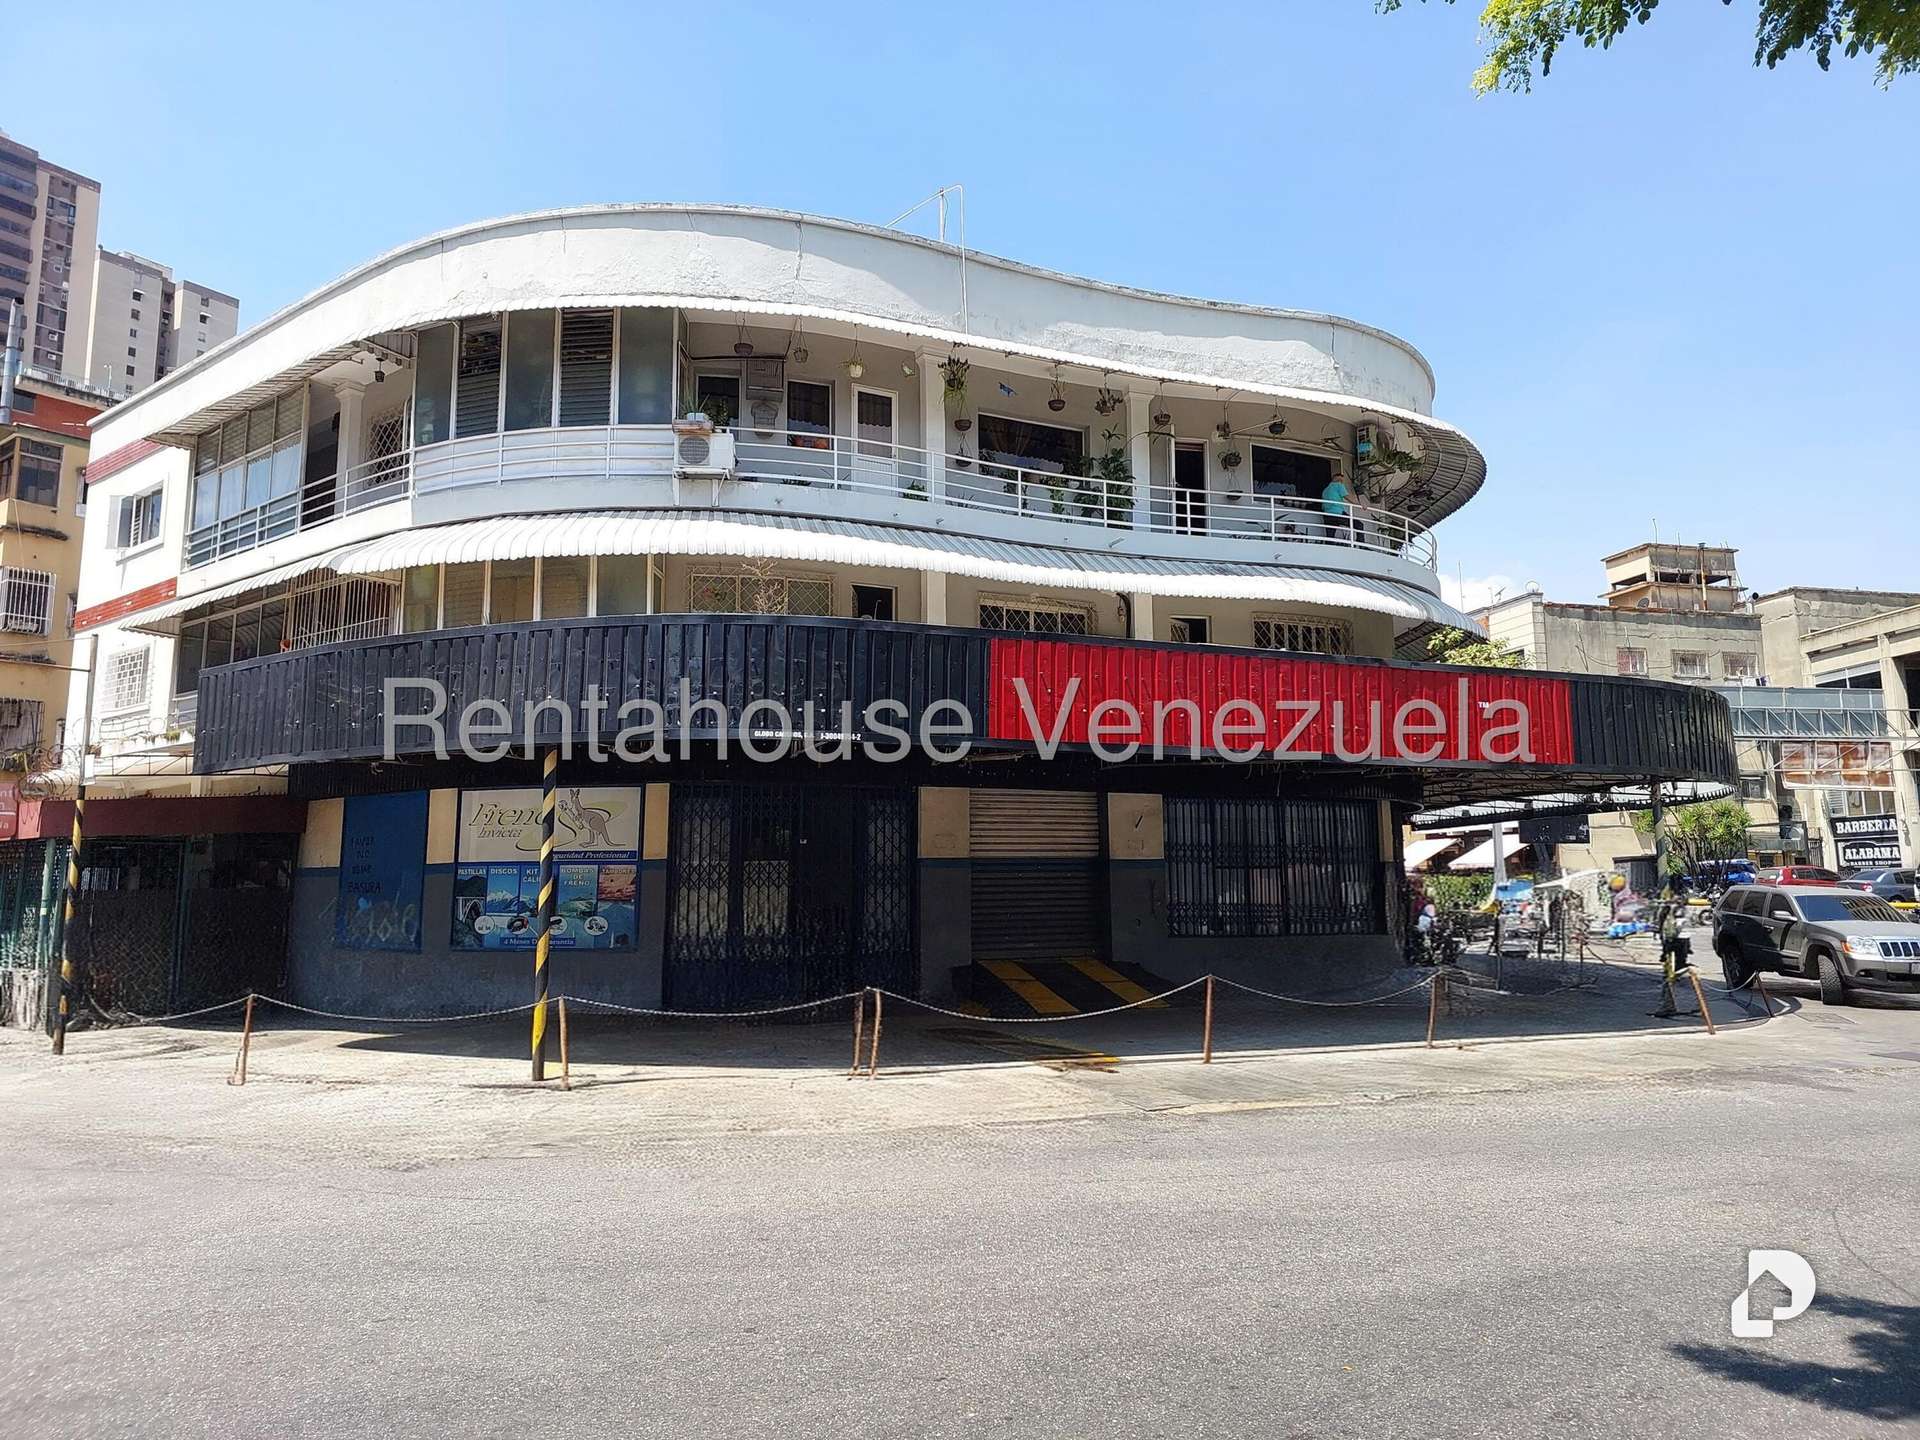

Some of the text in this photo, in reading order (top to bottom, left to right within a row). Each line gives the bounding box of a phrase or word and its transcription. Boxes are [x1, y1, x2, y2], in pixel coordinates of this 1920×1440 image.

[478, 826, 522, 839] Invicta
[1845, 847, 1900, 860] ALABAMA
[458, 868, 486, 876] PASTILLAS
